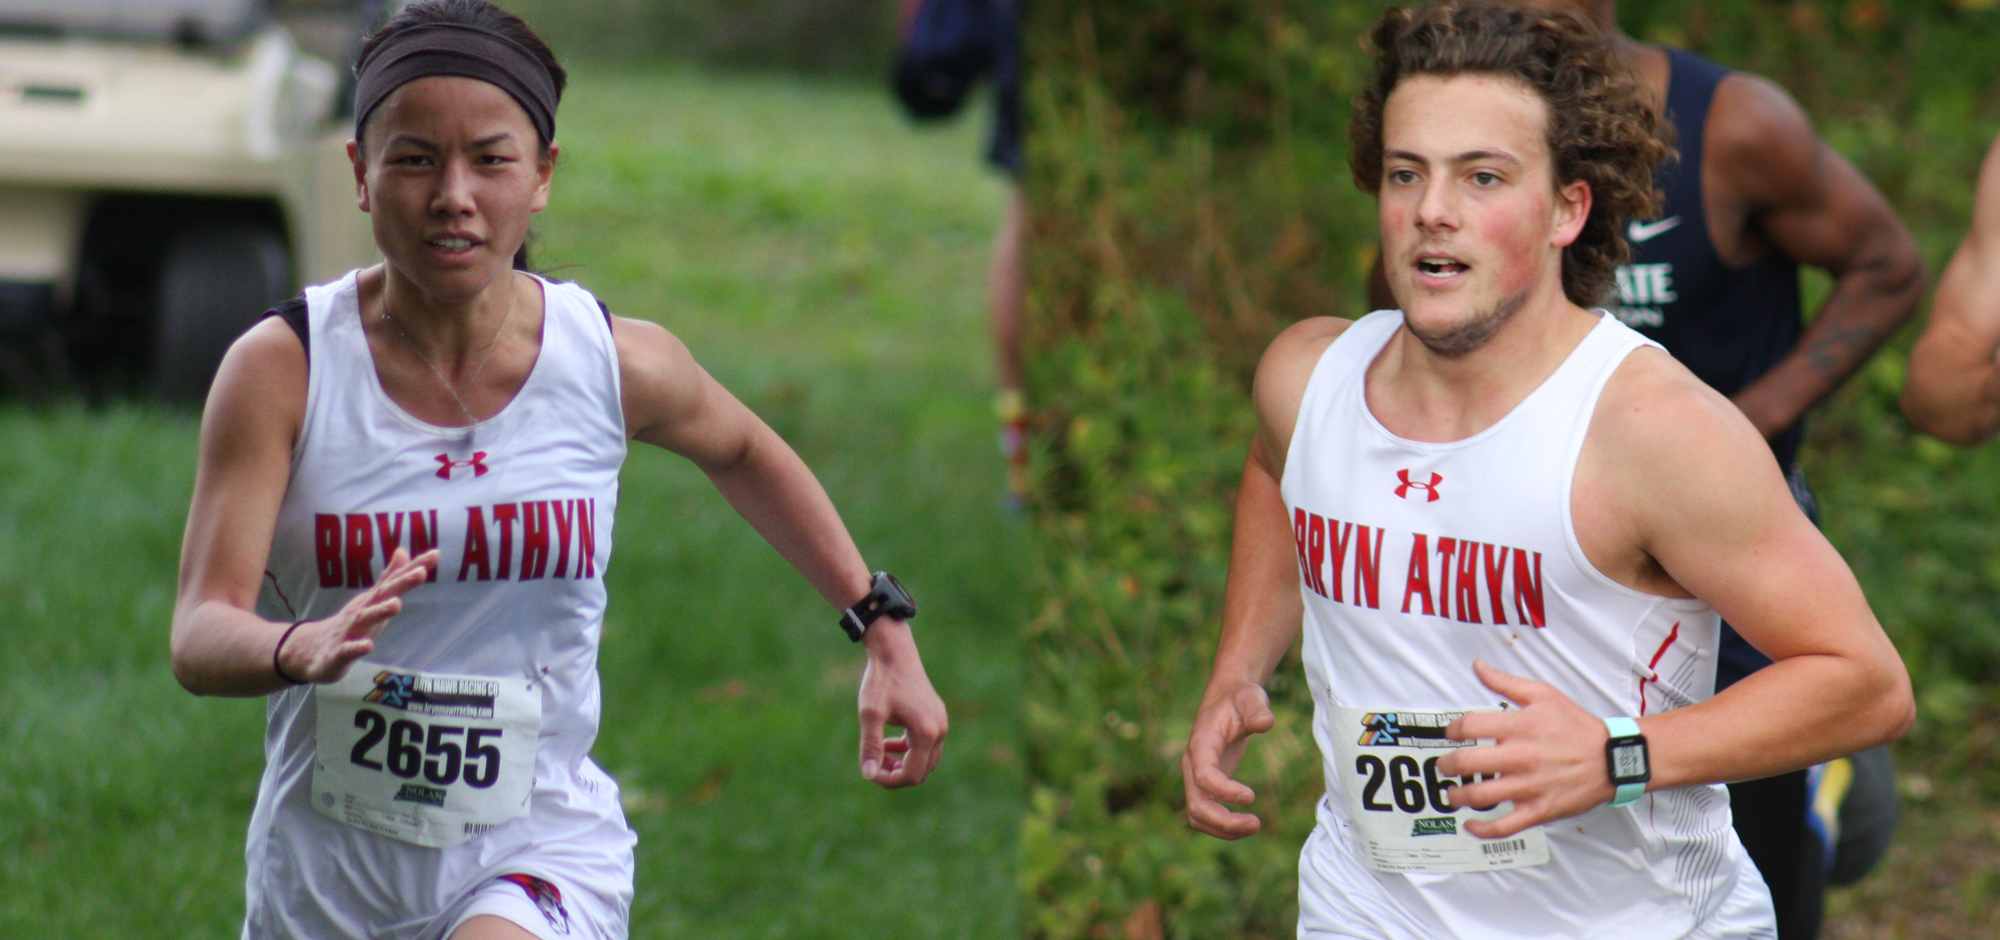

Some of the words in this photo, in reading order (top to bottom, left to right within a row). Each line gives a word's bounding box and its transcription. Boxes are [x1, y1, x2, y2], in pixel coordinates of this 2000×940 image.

[315, 509, 438, 589] BRYN
[456, 497, 595, 582] ATHYN
[1294, 506, 1385, 610] BRYN
[1400, 532, 1546, 628] ATHYN
[351, 709, 503, 788] 2655
[1356, 754, 1500, 813] 266
